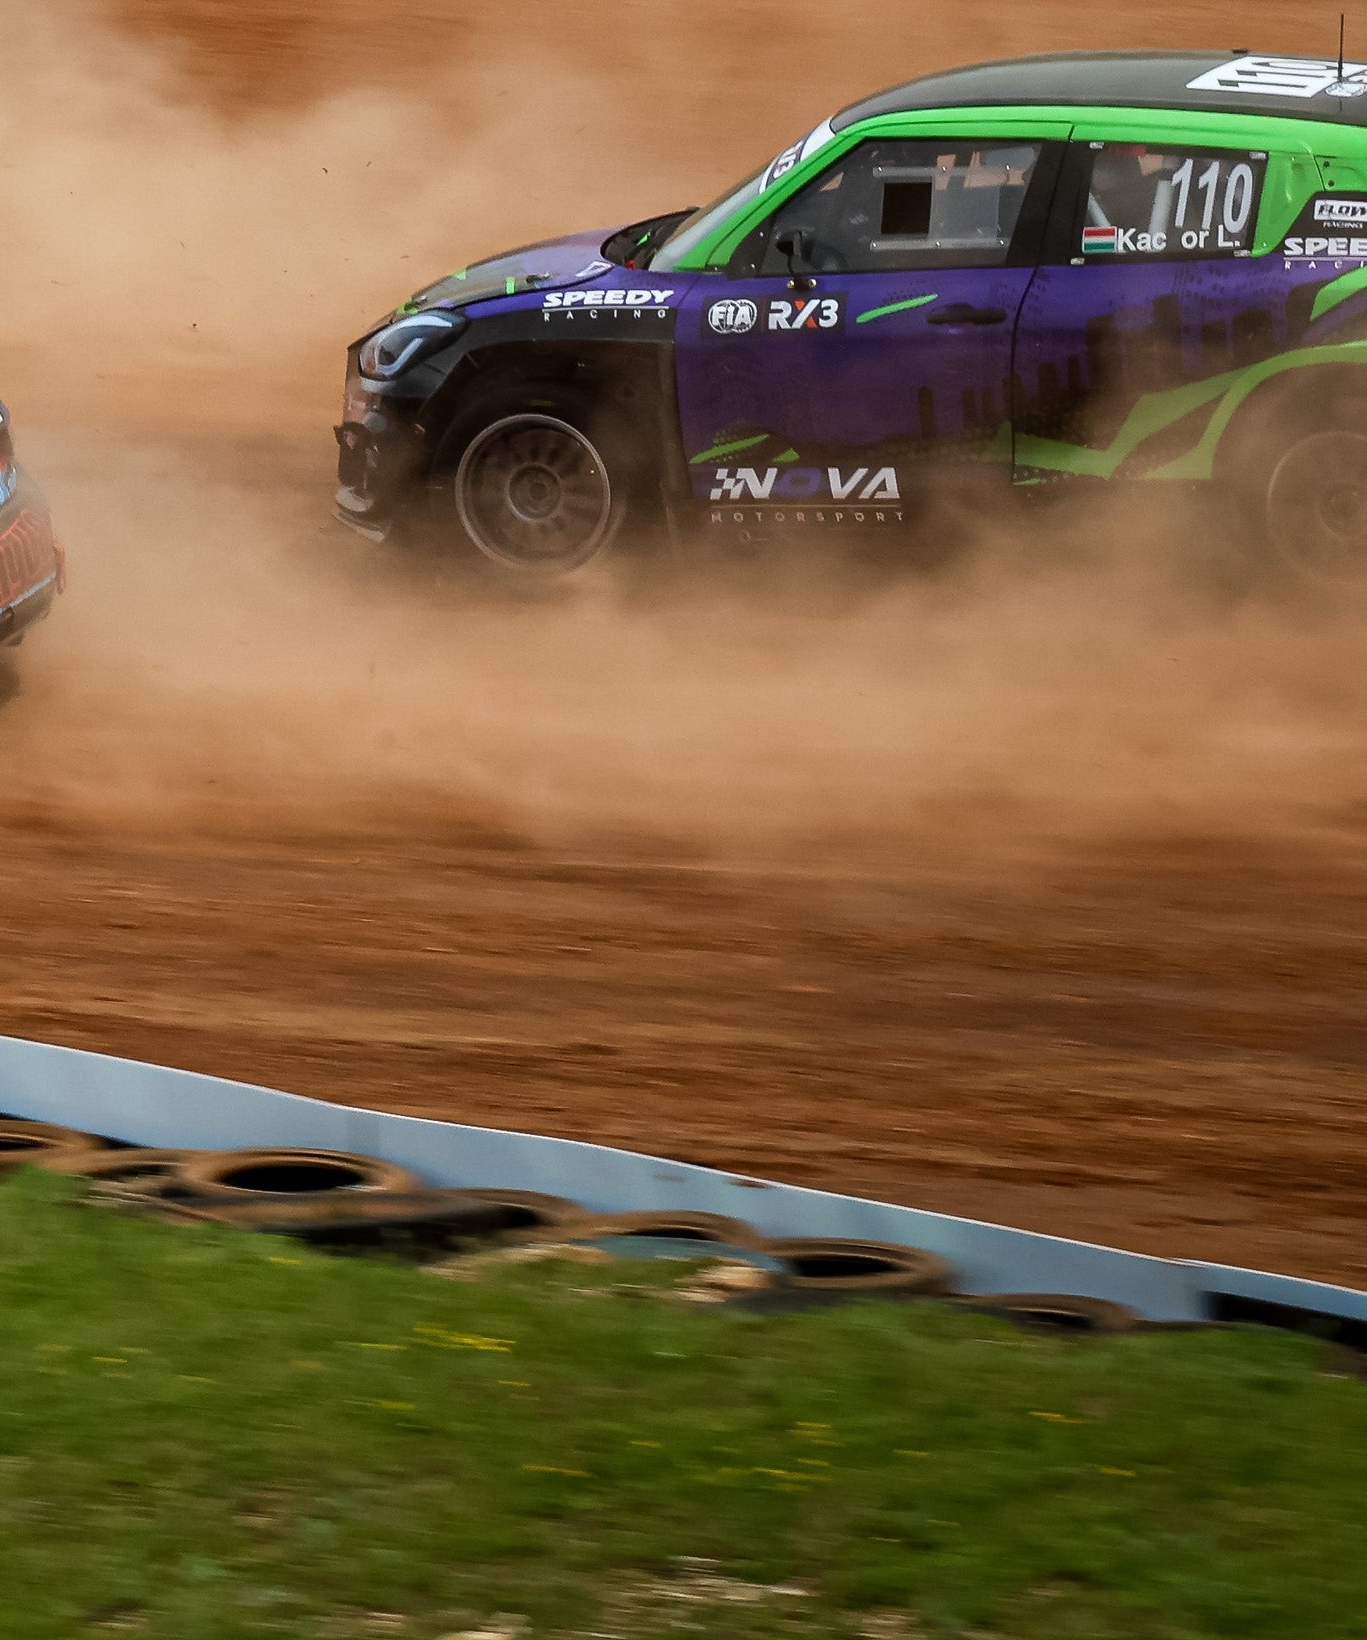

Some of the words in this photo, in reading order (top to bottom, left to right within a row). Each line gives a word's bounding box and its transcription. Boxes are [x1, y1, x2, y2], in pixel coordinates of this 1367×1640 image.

[1171, 158, 1254, 234] 110
[1217, 224, 1241, 248] L.
[1283, 237, 1367, 256] SPEE
[1285, 260, 1365, 271] RACI
[543, 289, 675, 308] SPEEDY
[543, 309, 667, 322] RACING
[710, 302, 754, 330] FIA
[768, 298, 840, 331] RX3
[710, 511, 904, 524] MOTORSPORT
